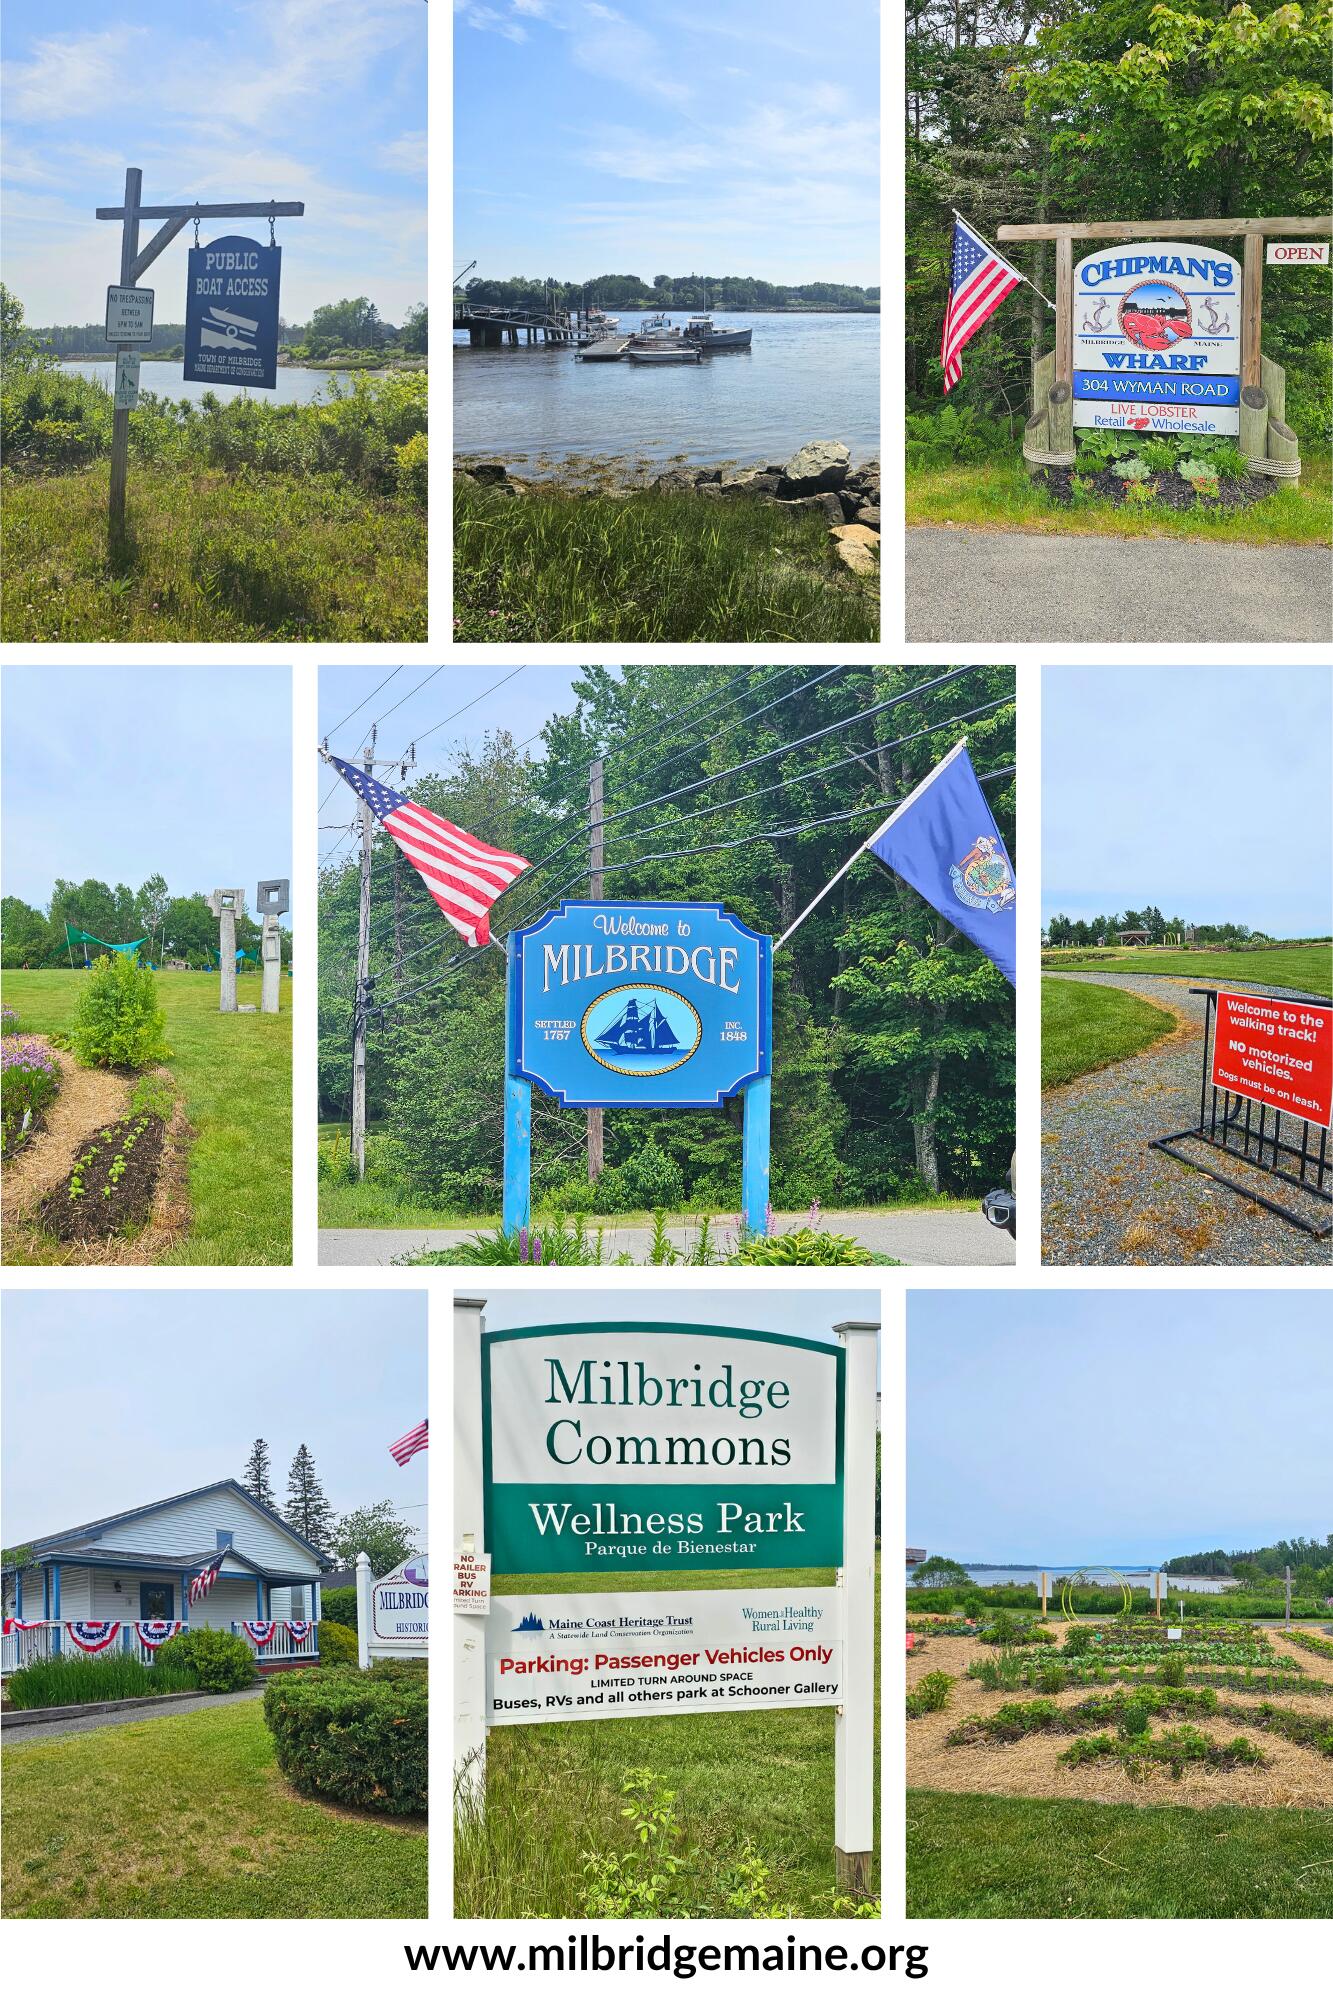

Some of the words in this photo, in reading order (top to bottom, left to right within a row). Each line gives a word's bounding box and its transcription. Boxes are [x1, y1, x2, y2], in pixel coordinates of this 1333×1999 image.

[205, 252, 258, 270] PUBLIC
[1274, 247, 1324, 260] OPEN
[1081, 256, 1234, 287] CHIPMAN'S
[196, 277, 223, 295] BOAT
[226, 277, 268, 296] ACCESS
[110, 294, 118, 303] NO
[120, 294, 152, 304] TRESPASSING
[198, 354, 217, 363] TOWN
[218, 356, 227, 364] OF
[228, 356, 262, 367] MILBRIDGE
[1102, 352, 1208, 371] WHARF
[1082, 379, 1109, 392] 304
[1113, 380, 1177, 395] WYMAN
[1181, 384, 1229, 396] ROAD
[1111, 404, 1136, 415] LIVE
[1140, 405, 1198, 418] LOBSTER
[1094, 415, 1125, 427] Retail
[1152, 418, 1216, 432] Wholesale
[594, 914, 669, 936] Welcome
[677, 919, 691, 936] to
[542, 944, 741, 994] MILBRIDGE
[1227, 1000, 1280, 1019] Welcome
[1282, 1010, 1296, 1023] to
[1300, 1013, 1324, 1028] the
[534, 1020, 577, 1029] SETTLED
[725, 1021, 743, 1030] INC.
[1230, 1016, 1275, 1036] walking
[1278, 1026, 1317, 1043] track!
[543, 1030, 570, 1041] 1757
[720, 1031, 748, 1042] 1848
[1228, 1040, 1246, 1053] NO
[1248, 1046, 1313, 1072] motorized
[1242, 1058, 1294, 1082] vehicles.
[1218, 1068, 1238, 1082] Dogs
[1240, 1077, 1262, 1090] must
[1264, 1082, 1276, 1095] be
[1277, 1090, 1290, 1100] on
[1292, 1092, 1323, 1112] leash.
[544, 1358, 790, 1419] Milbridge
[546, 1419, 792, 1466] Commons
[528, 1502, 704, 1536] Wellness
[716, 1502, 806, 1533] Park
[584, 1541, 648, 1558] Parque
[652, 1540, 672, 1554] de
[676, 1540, 757, 1554] Bienestar
[742, 1608, 779, 1619] Women
[785, 1606, 823, 1620] Healthy
[549, 1620, 583, 1629] Maine
[586, 1618, 616, 1627] Coast
[620, 1616, 664, 1628] Heritage
[666, 1616, 693, 1626] Trust
[752, 1620, 780, 1631] Rural
[783, 1620, 814, 1632] Living
[653, 1628, 694, 1637] Organization
[500, 1655, 590, 1676] Parking:
[595, 1654, 700, 1670] Passenger
[704, 1647, 785, 1664] Vehicles
[790, 1645, 834, 1664] Only
[590, 1678, 635, 1688] LIMITED
[638, 1676, 668, 1685] TURN
[670, 1674, 717, 1684] AROUND
[720, 1672, 754, 1682] SPACE
[493, 1698, 542, 1710] Buses,
[546, 1695, 572, 1706] RVs
[576, 1693, 604, 1705] and
[608, 1691, 624, 1703] all
[628, 1689, 672, 1702] others
[676, 1687, 708, 1702] park
[711, 1688, 725, 1697] at
[728, 1684, 790, 1697] Schooner
[794, 1682, 838, 1695] Gallery
